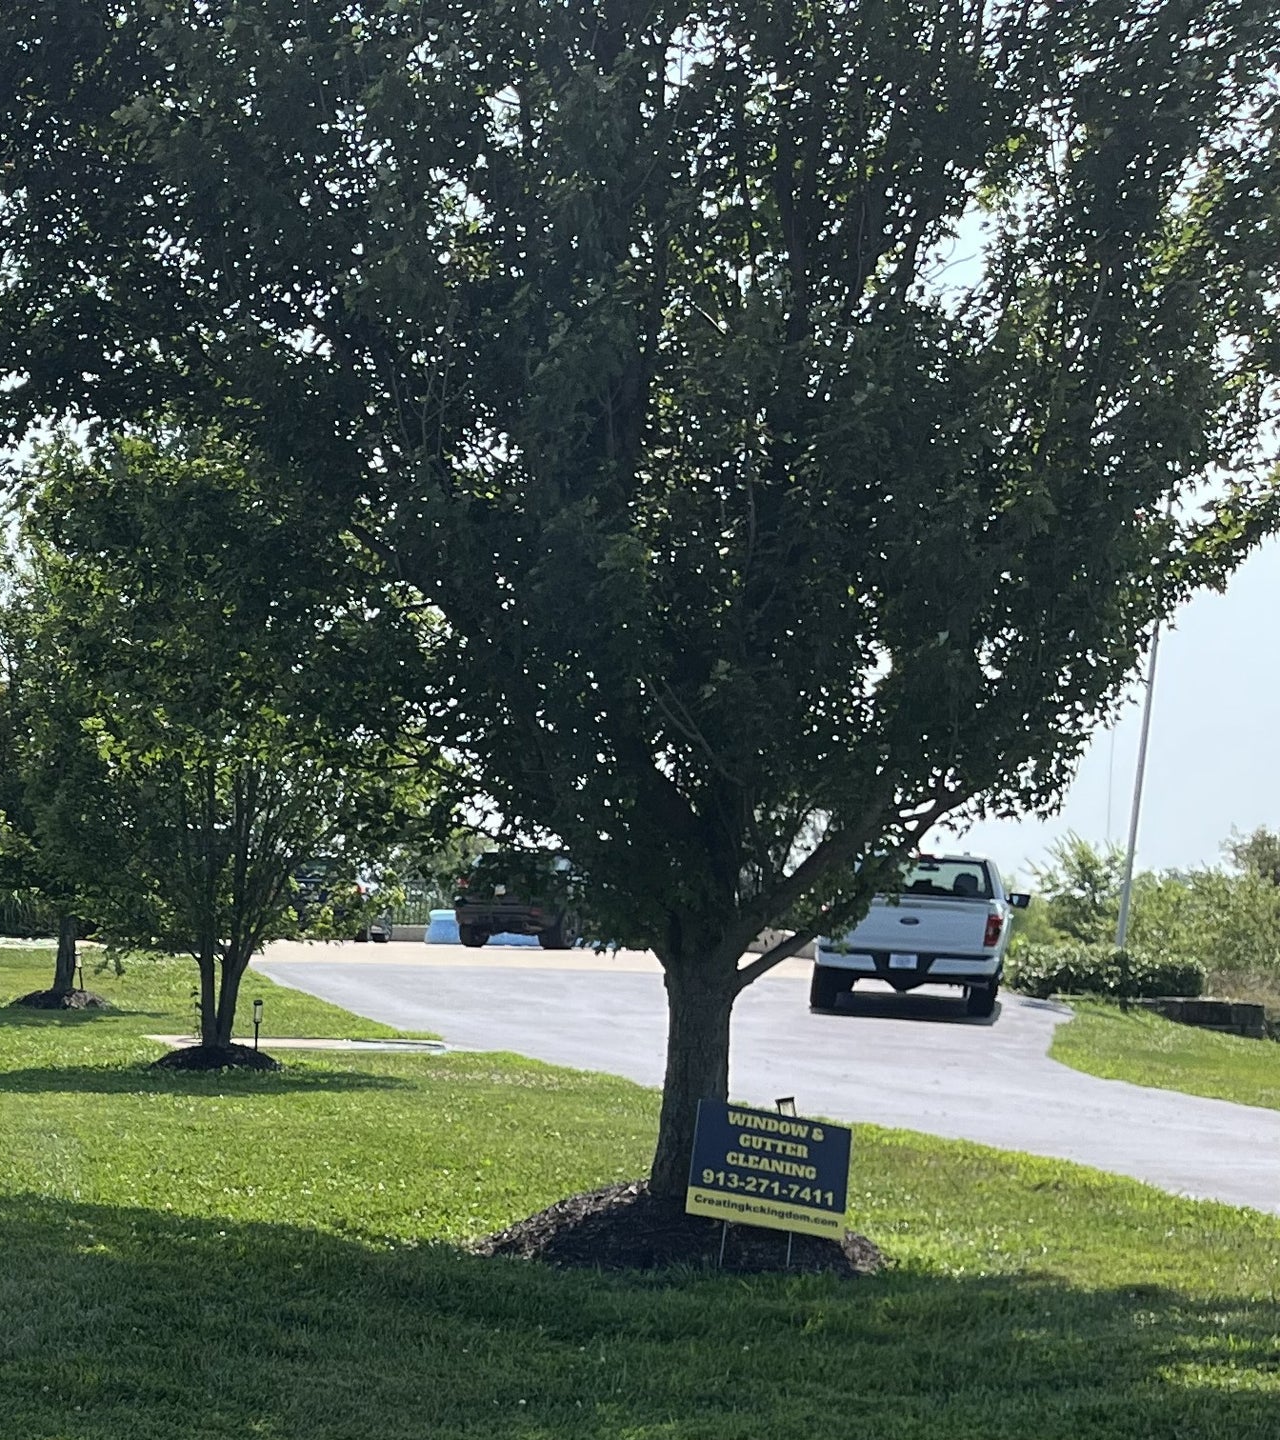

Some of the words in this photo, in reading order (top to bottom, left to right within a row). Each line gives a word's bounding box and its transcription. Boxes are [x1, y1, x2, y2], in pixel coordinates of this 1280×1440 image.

[727, 1110, 809, 1139] WINDOW
[811, 1127, 825, 1142] &
[739, 1133, 809, 1159] GUTTER
[726, 1151, 817, 1180] CLEANING
[702, 1168, 834, 1207] 913-271-7411
[694, 1193, 839, 1229] Creatingkckingdom.com
